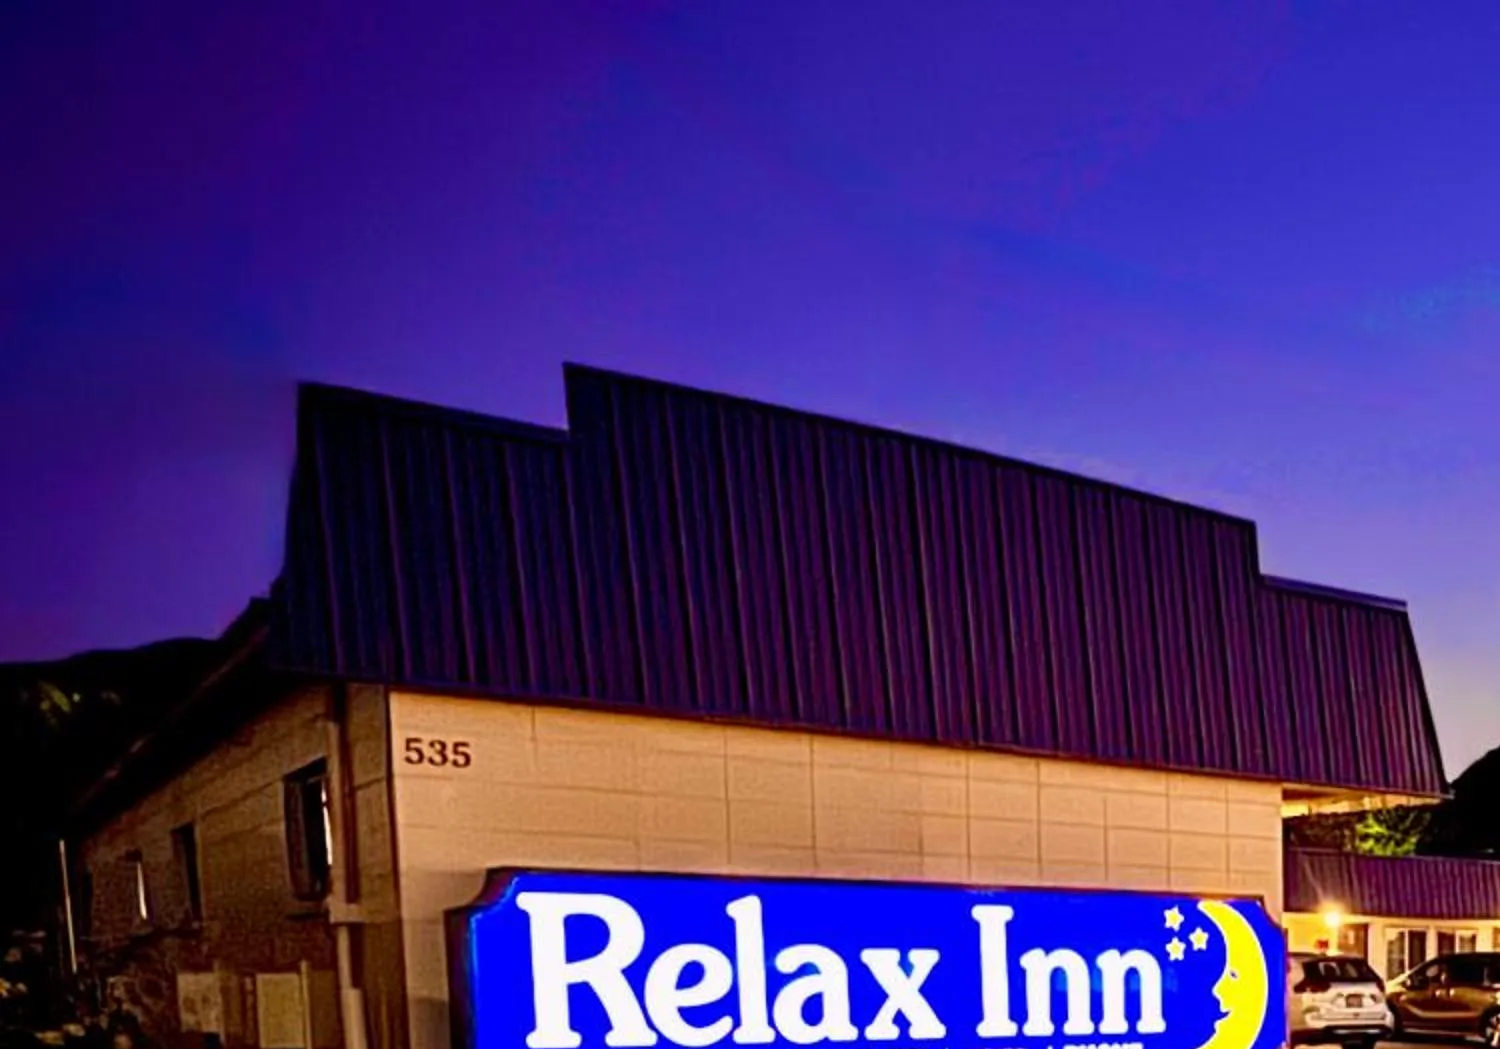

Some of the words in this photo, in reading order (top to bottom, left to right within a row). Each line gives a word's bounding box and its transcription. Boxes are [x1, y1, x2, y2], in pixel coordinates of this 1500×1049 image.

[404, 737, 472, 768] 535
[515, 891, 947, 1049] Relax
[971, 904, 1167, 1038] Inn
